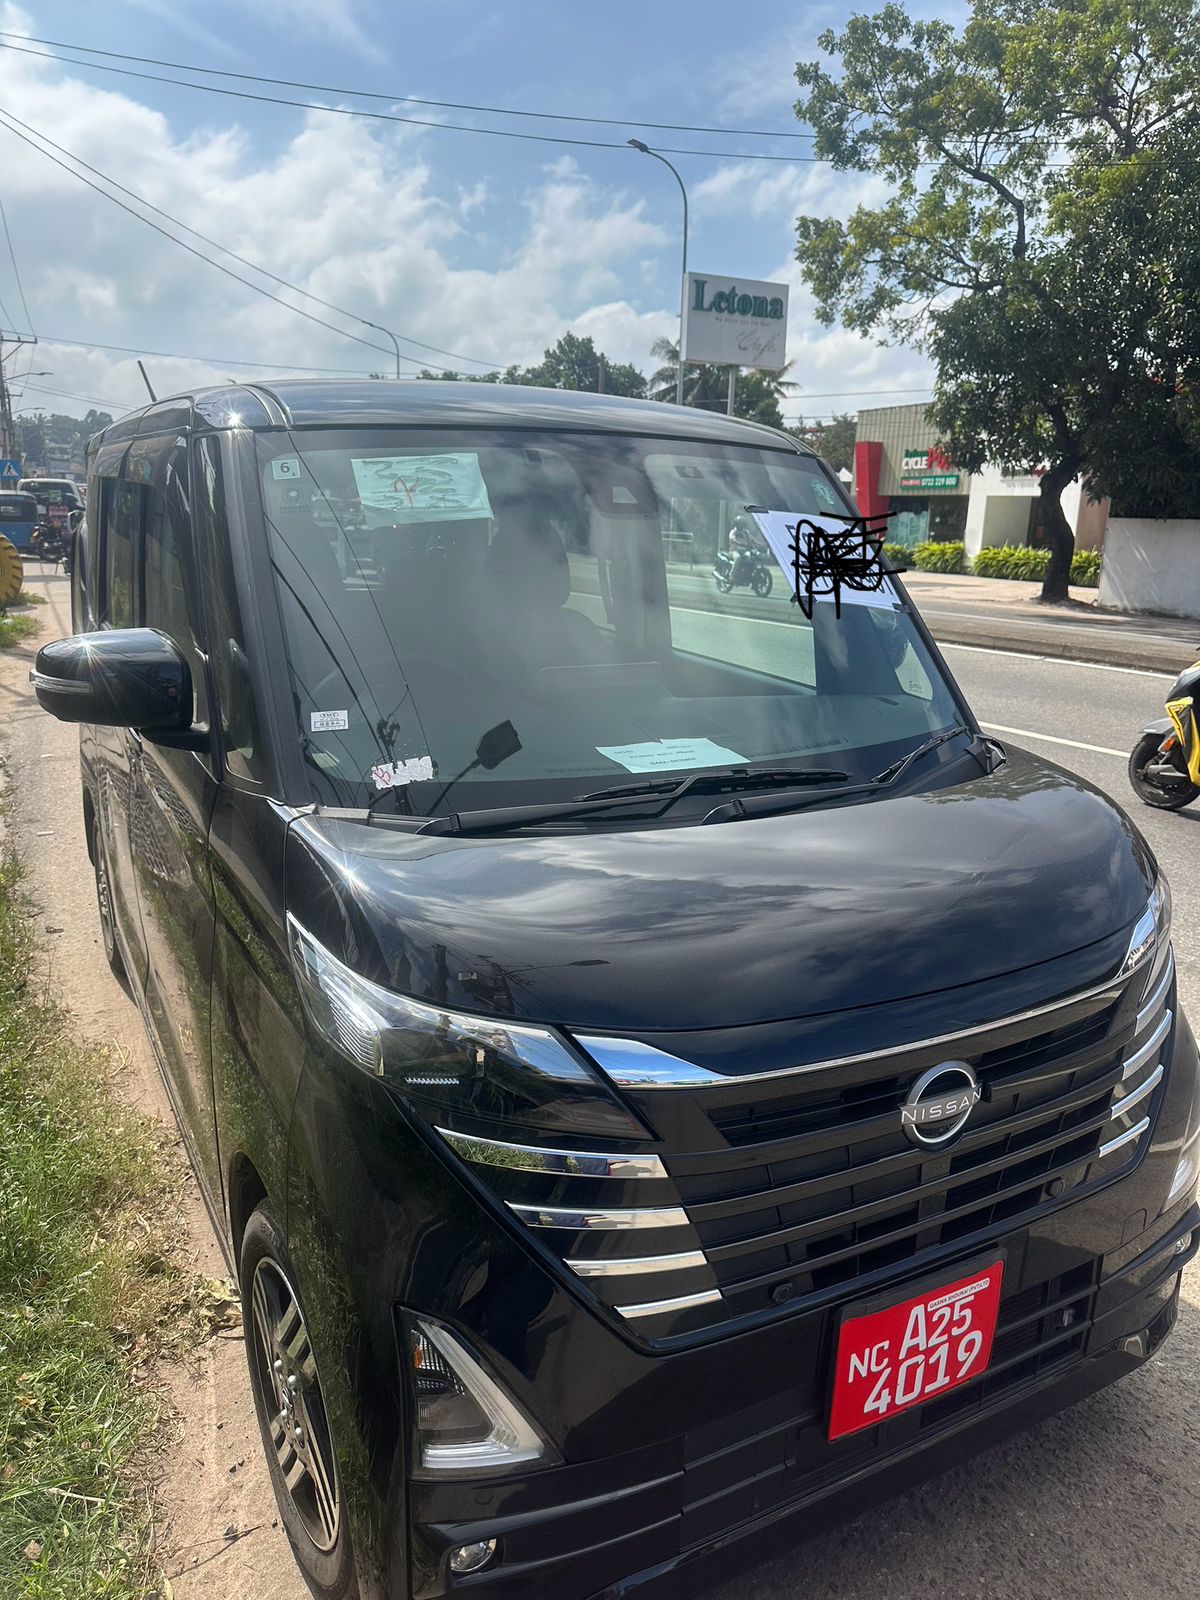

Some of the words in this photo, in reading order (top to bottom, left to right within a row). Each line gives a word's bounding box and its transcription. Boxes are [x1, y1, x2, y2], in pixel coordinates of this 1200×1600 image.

[692, 279, 785, 320] Letona
[279, 461, 290, 474] 6
[901, 456, 928, 470] CYCLE
[901, 1086, 982, 1124] NISSAN
[847, 1339, 891, 1384] NC
[862, 1329, 984, 1415] 4019
